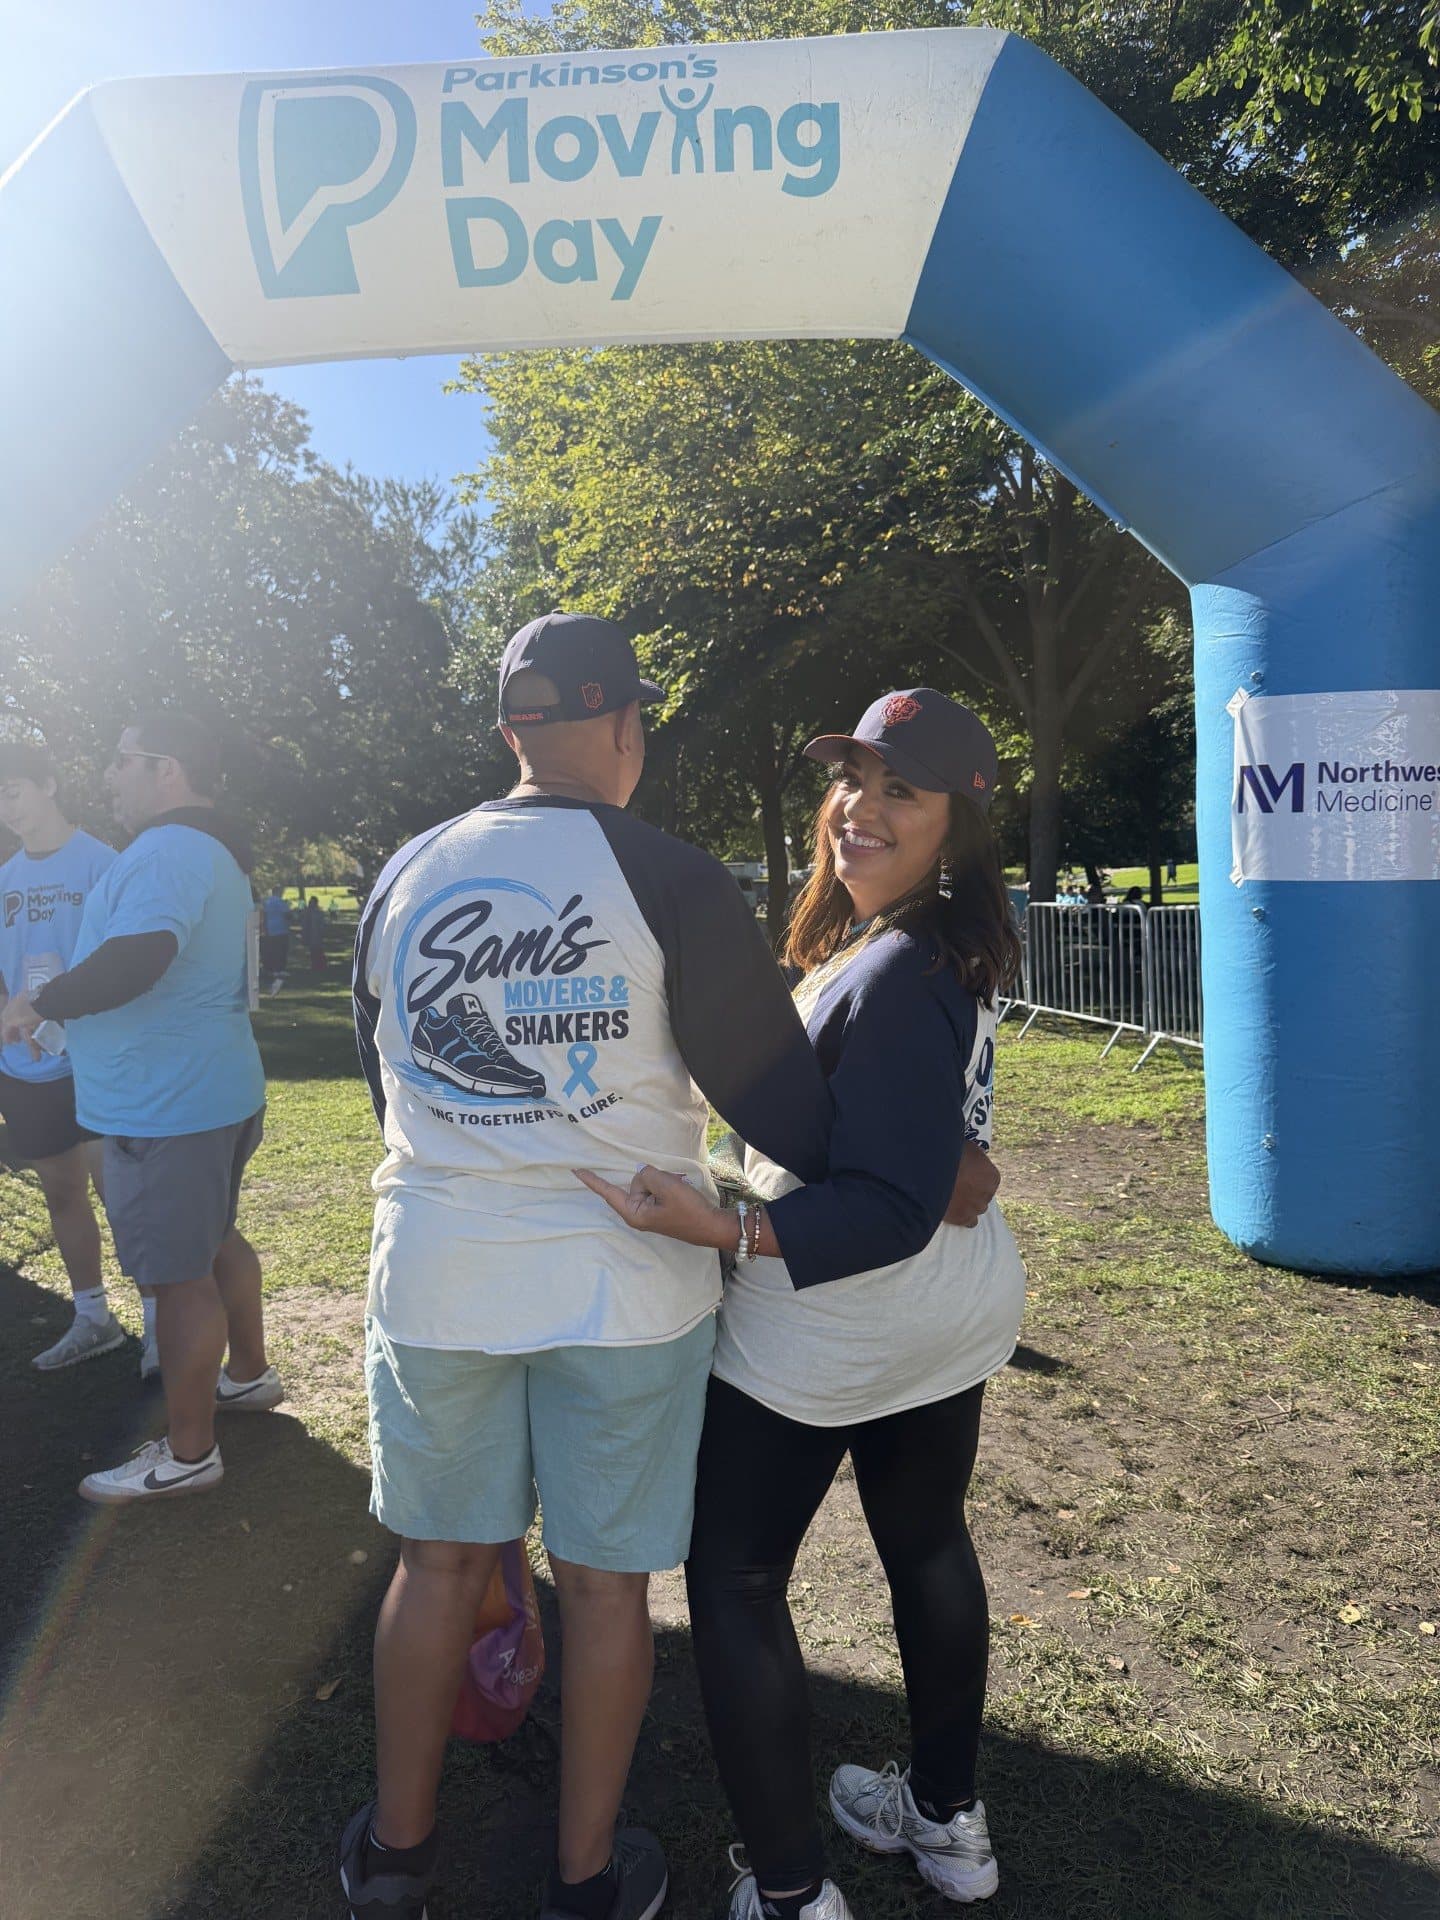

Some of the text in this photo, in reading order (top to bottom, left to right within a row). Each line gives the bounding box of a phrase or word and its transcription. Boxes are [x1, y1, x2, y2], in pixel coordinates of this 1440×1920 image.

[441, 53, 718, 93] Parkinson's
[440, 82, 841, 197] Moving
[444, 197, 663, 300] Day
[1317, 788, 1433, 812] Medicine
[28, 908, 56, 923] Day
[407, 894, 611, 1013] Sam's
[504, 975, 629, 1008] MOVERS &
[505, 1010, 630, 1046] SHAKERS
[458, 1109, 545, 1126] TOGETHER
[567, 1113, 579, 1123] A
[580, 1092, 624, 1119] CURE.
